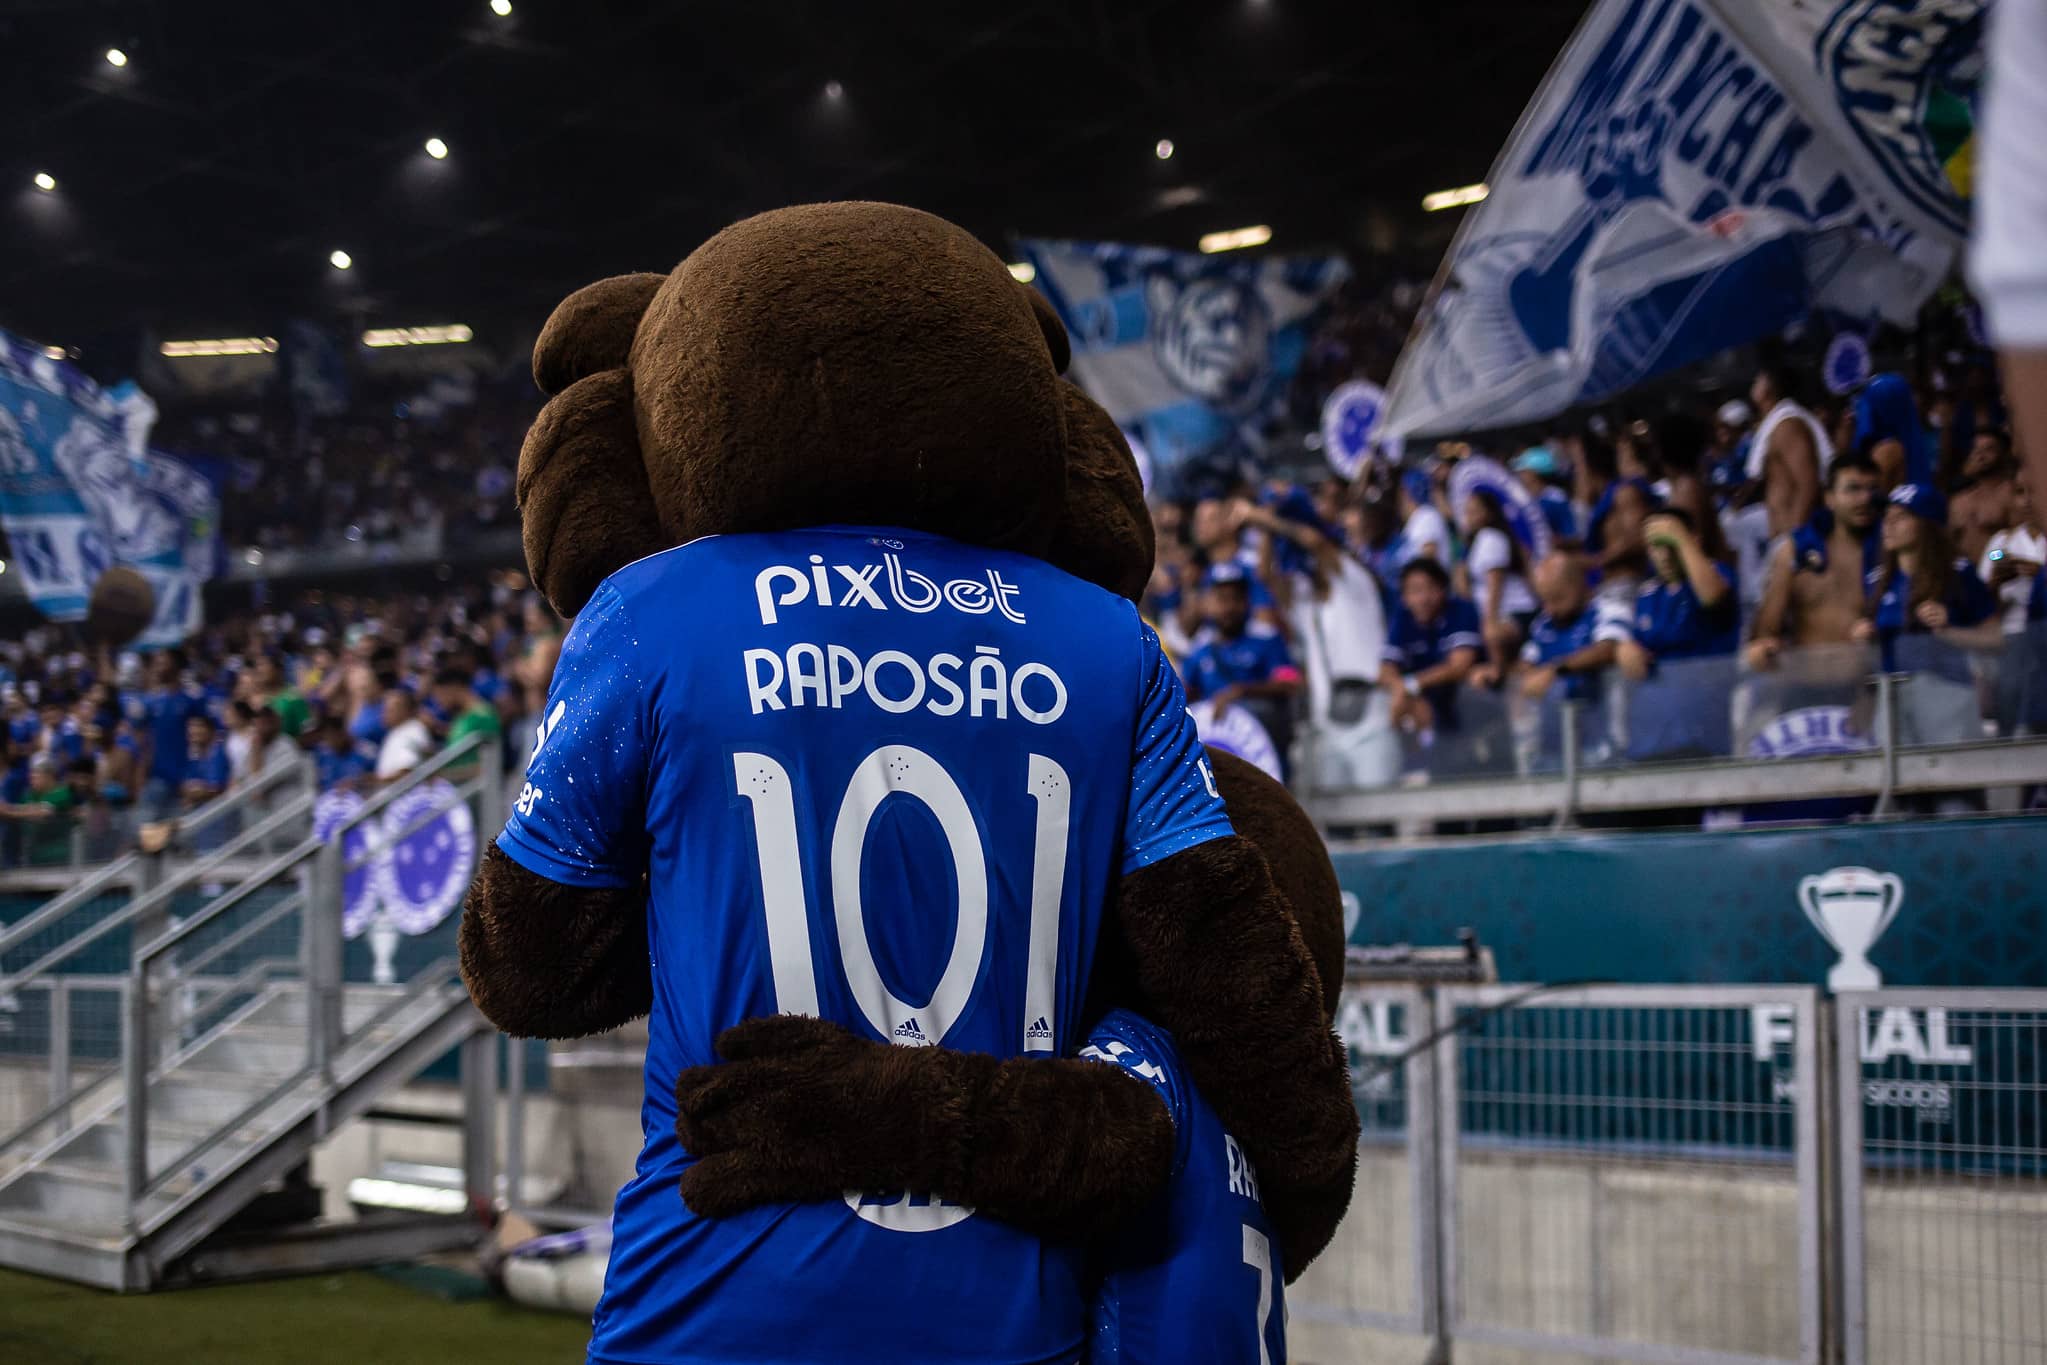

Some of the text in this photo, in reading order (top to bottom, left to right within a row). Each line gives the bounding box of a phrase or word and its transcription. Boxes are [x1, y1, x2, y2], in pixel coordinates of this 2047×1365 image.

[755, 552, 1027, 625] pixbet
[743, 642, 1068, 725] RAPOSÃO
[733, 744, 1071, 1052] 101
[894, 1028, 926, 1041] adidas
[1026, 1026, 1053, 1039] adidas
[1753, 1003, 1973, 1065] FAL
